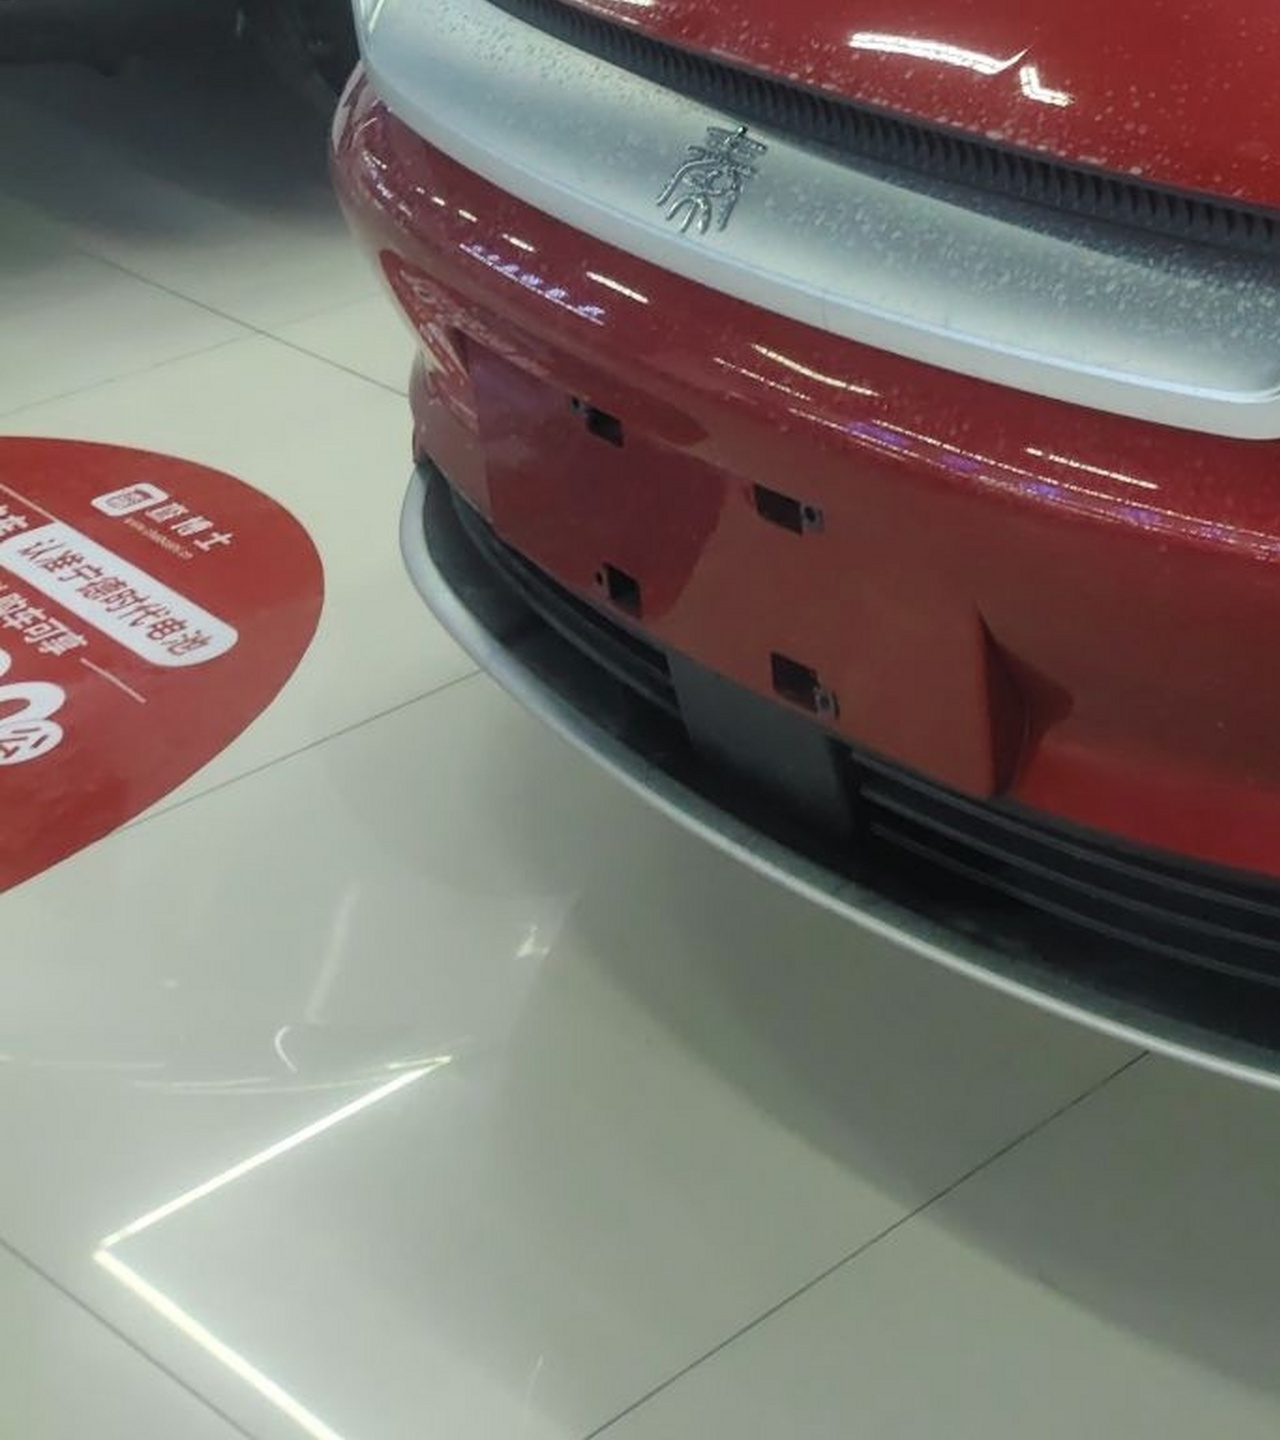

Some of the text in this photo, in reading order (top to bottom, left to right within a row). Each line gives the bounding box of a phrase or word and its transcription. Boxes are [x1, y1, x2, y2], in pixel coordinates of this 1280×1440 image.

[17, 536, 212, 658] 认准宁德时代电池
